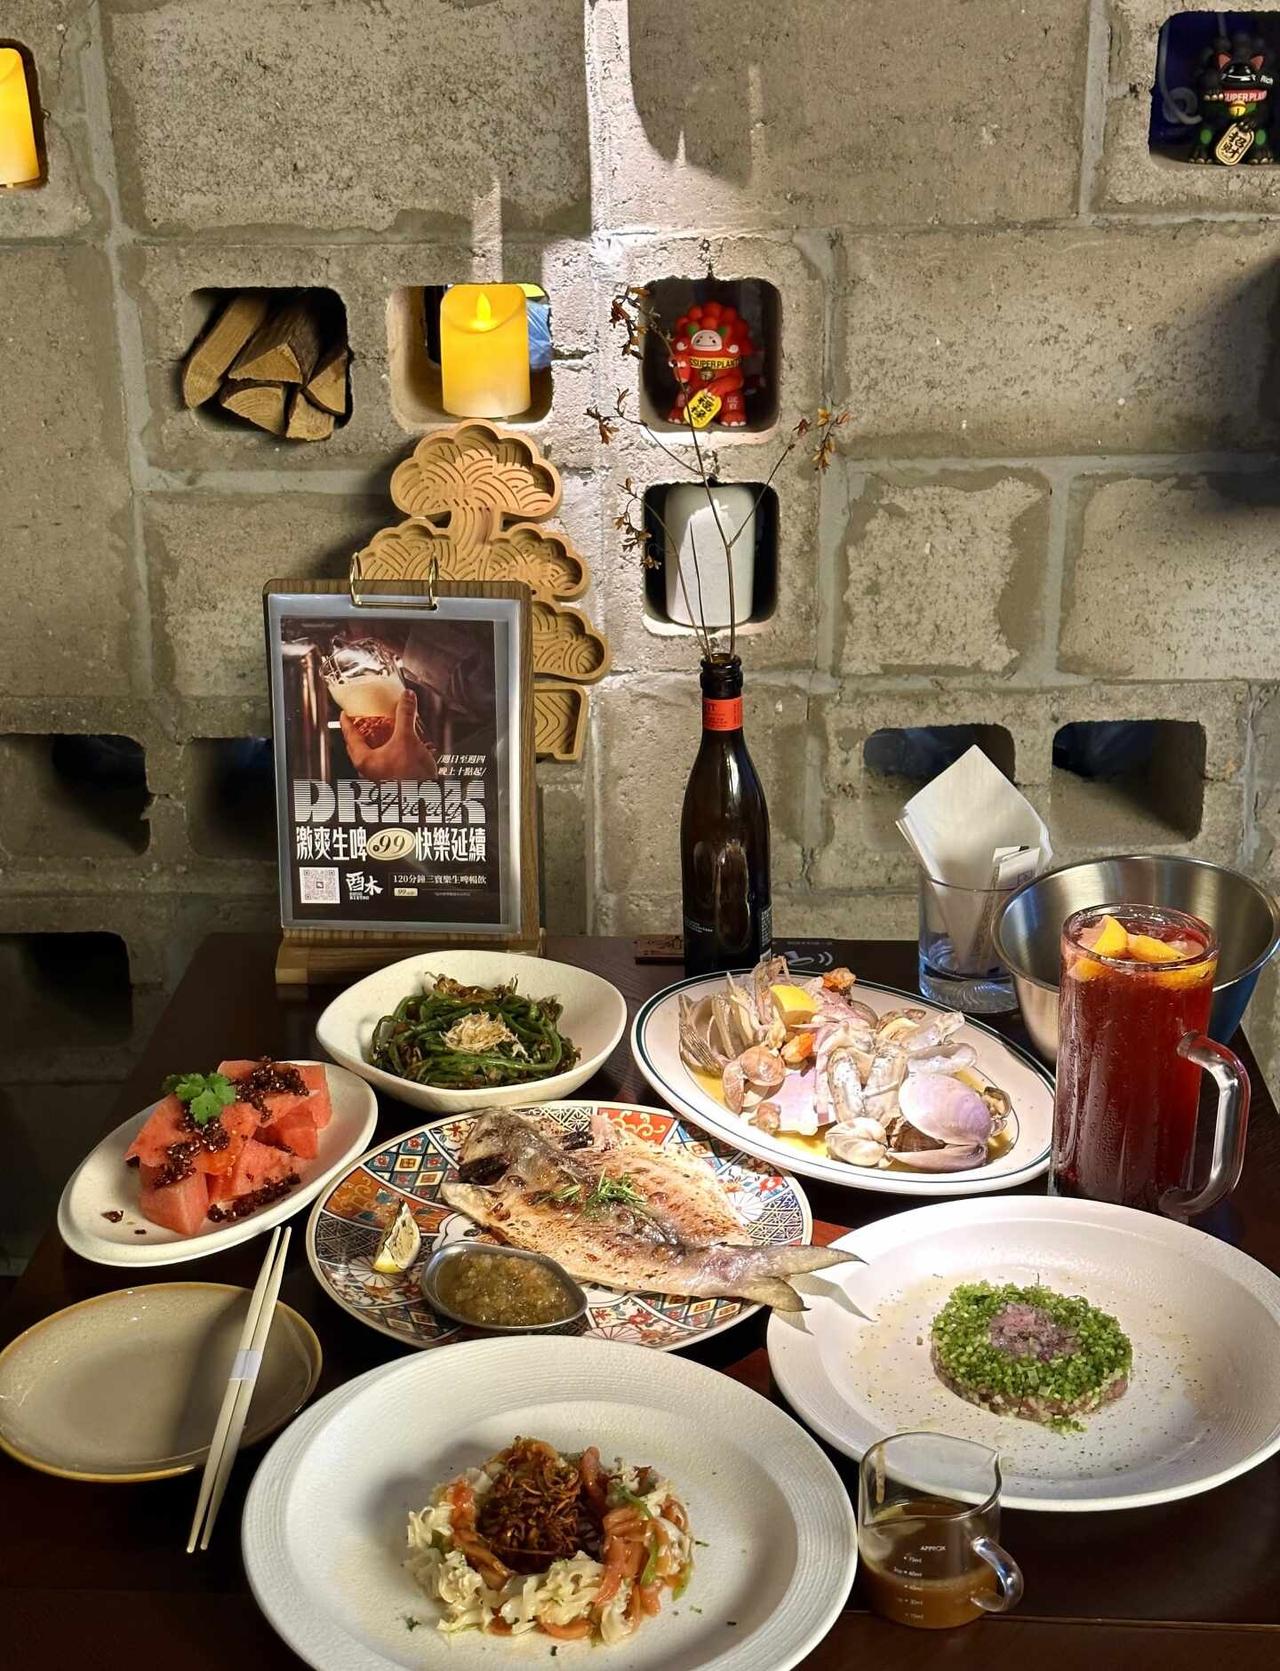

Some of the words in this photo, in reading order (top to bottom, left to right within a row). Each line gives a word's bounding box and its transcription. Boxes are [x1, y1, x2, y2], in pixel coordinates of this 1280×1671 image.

[296, 826, 367, 861] 激爽生啤
[415, 827, 486, 862] 快樂延續
